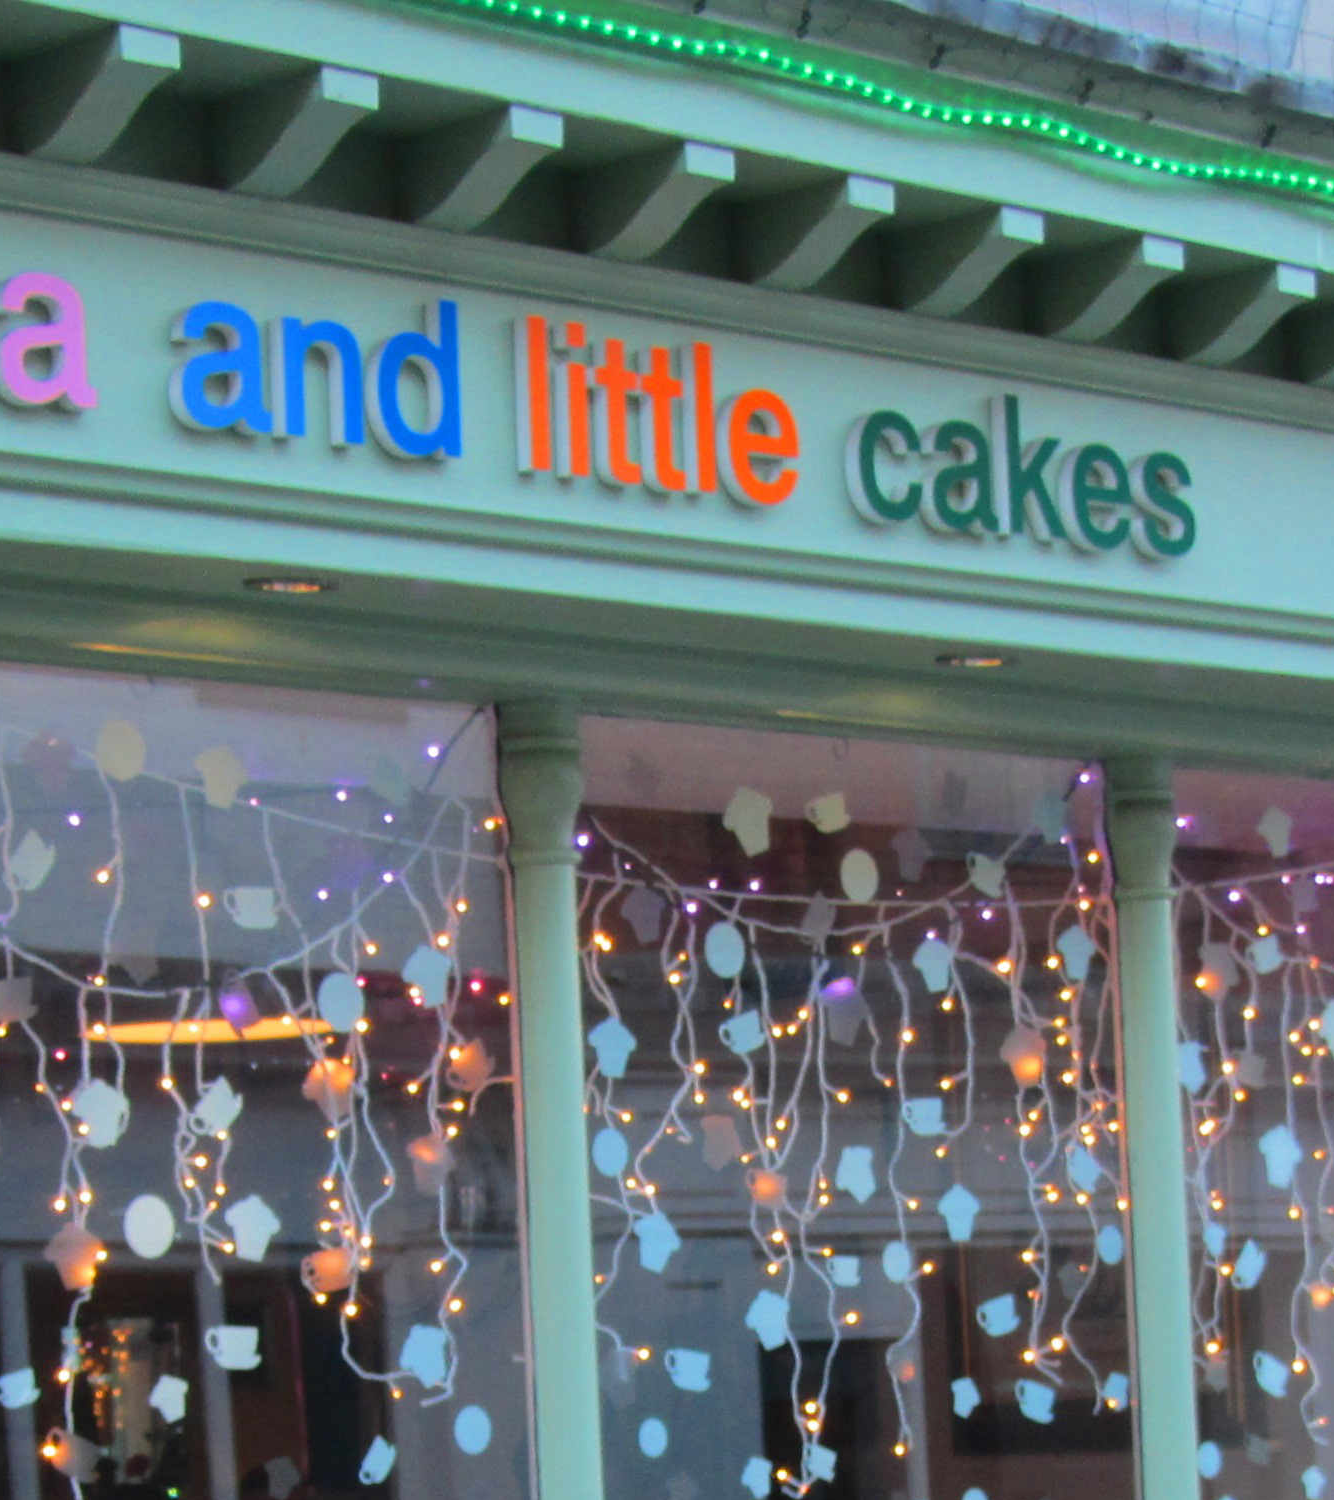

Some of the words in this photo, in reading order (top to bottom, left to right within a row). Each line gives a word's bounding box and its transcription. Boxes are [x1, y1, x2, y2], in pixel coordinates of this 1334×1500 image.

[172, 300, 463, 460] and
[517, 314, 800, 505] little
[849, 393, 1197, 556] cakes
